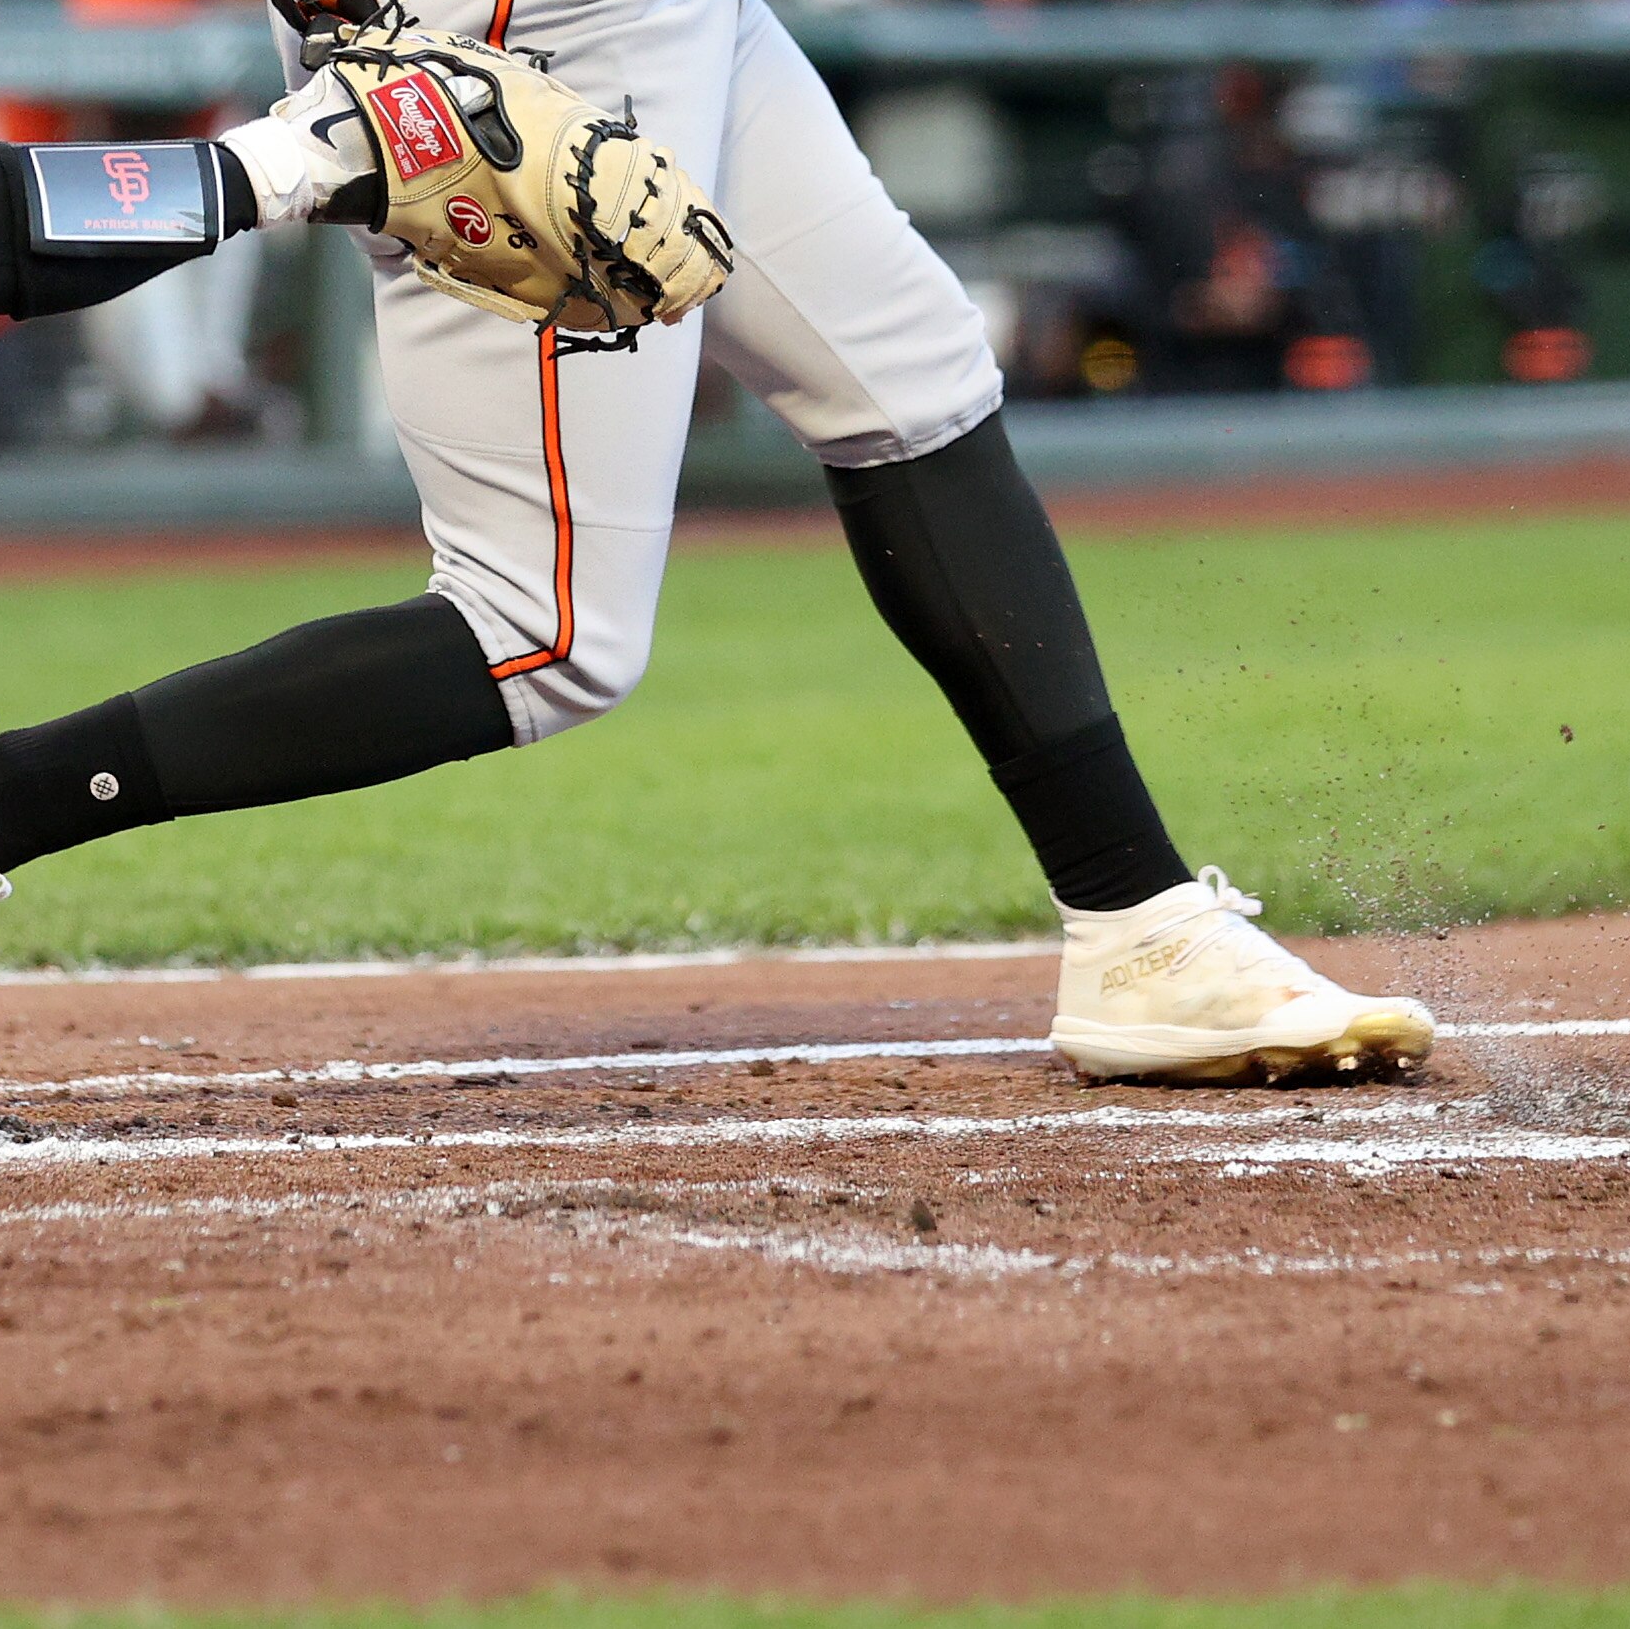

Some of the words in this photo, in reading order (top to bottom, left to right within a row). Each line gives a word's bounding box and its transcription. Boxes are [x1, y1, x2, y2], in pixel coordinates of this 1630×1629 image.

[390, 86, 443, 157] Rawlings
[102, 151, 150, 214] SF
[84, 219, 138, 230] PATRICK
[142, 219, 186, 230] BAILEY
[448, 201, 489, 241] R
